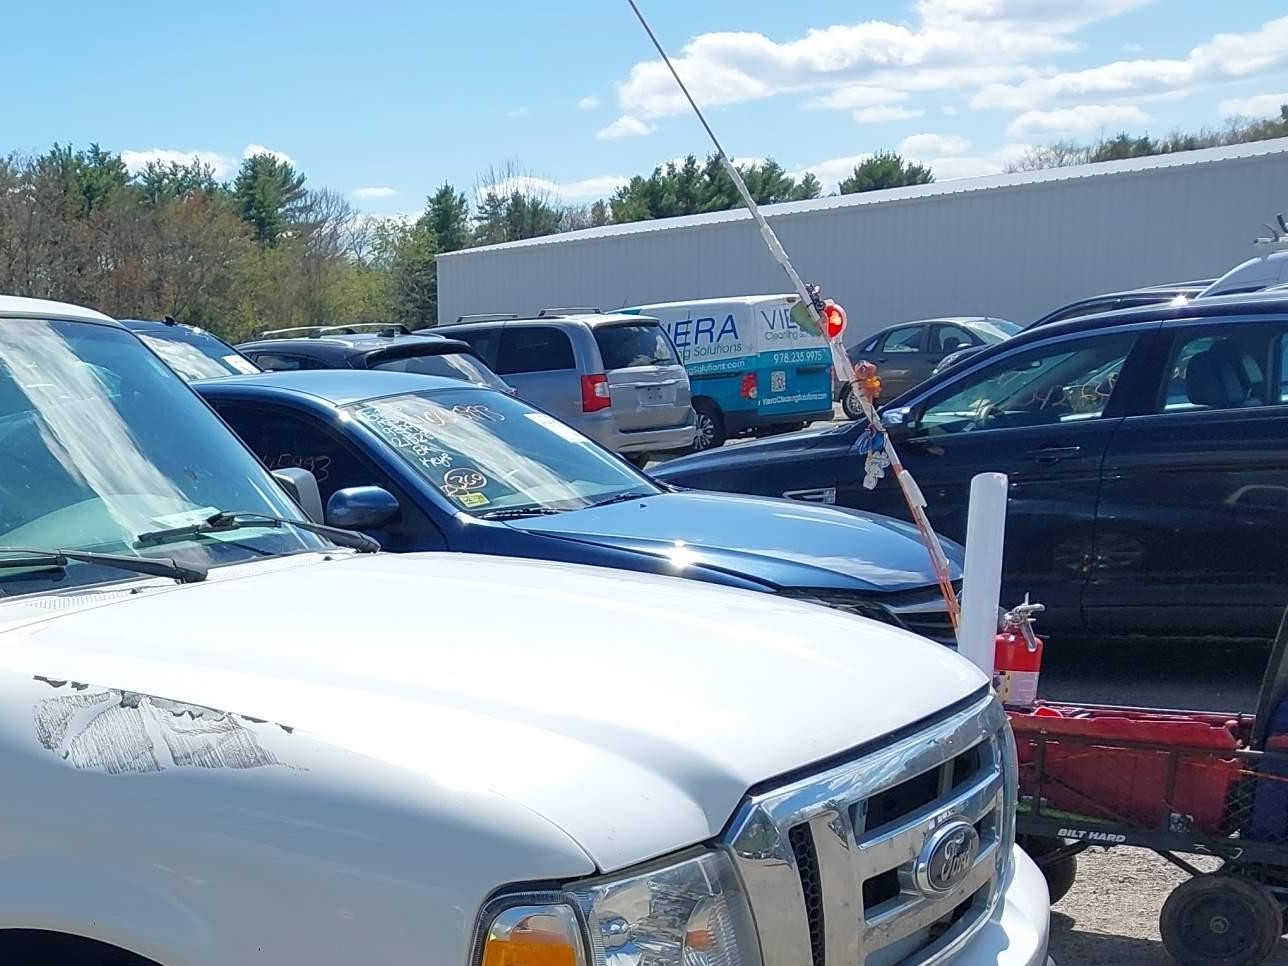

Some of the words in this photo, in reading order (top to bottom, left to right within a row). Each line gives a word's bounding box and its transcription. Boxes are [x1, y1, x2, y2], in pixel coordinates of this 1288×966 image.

[761, 309, 797, 330] VIE
[663, 314, 739, 347] ERA
[694, 342, 742, 357] Solutions
[773, 350, 823, 364] 978.235.9975
[1057, 828, 1087, 838] BILT
[1088, 831, 1126, 842] HARD
[941, 832, 973, 882] Ford
